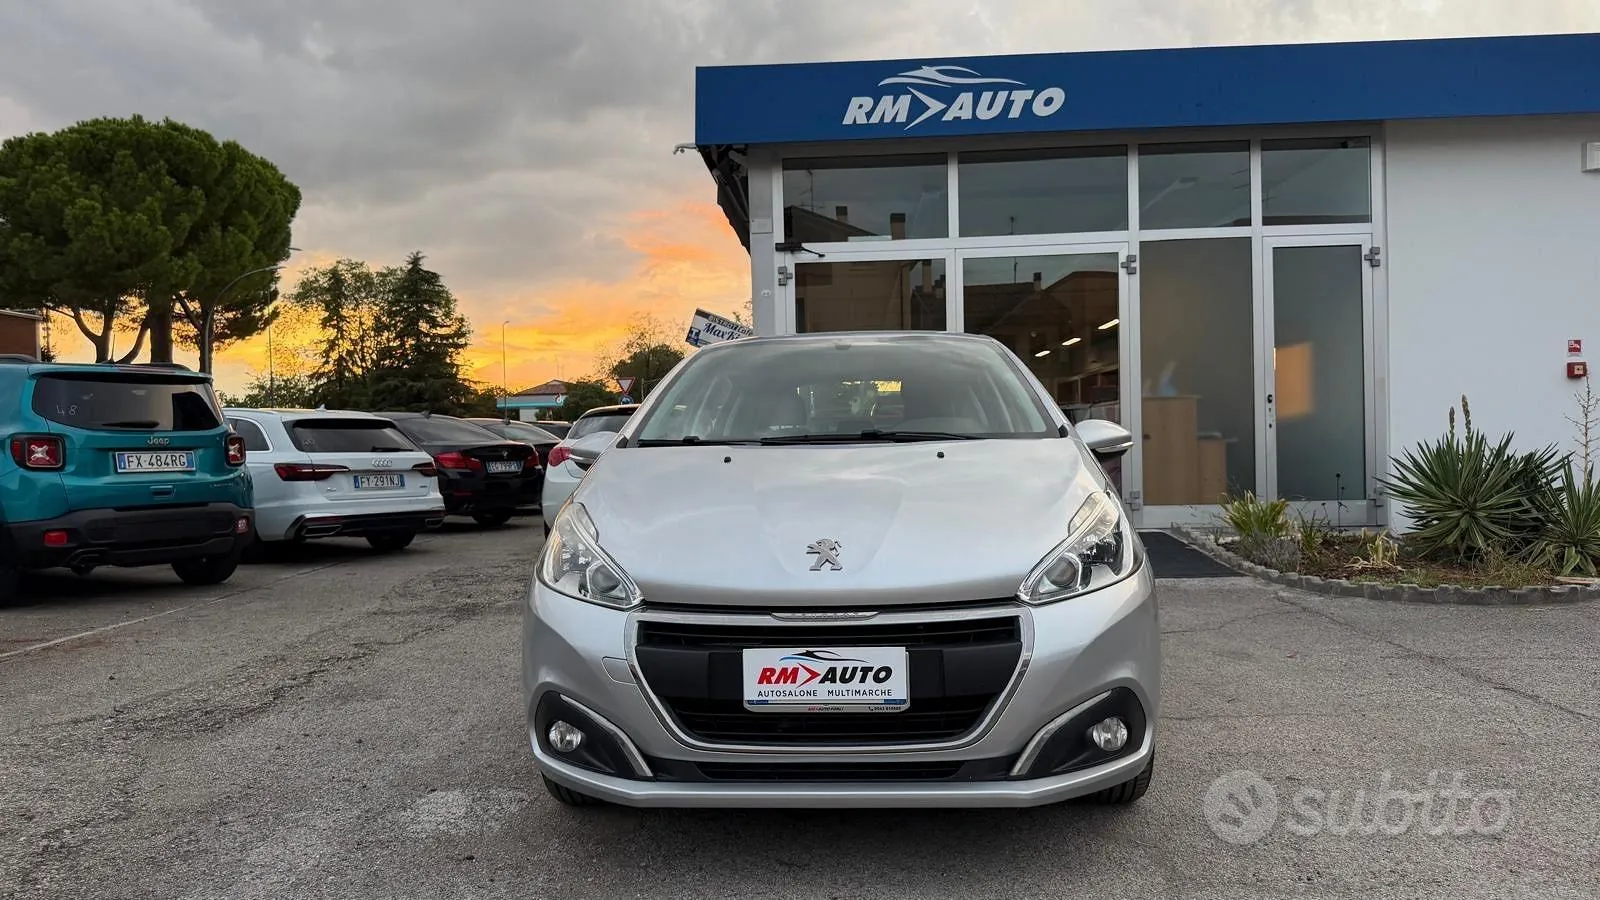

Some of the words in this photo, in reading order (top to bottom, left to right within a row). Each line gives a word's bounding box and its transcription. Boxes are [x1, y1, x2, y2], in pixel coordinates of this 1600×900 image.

[842, 94, 912, 125] RM
[941, 87, 1065, 121] AUTO
[147, 436, 170, 446] Jeep
[127, 454, 142, 468] FX
[757, 666, 800, 685] RM
[818, 665, 893, 684] AUTO
[757, 689, 818, 697] AUTOSALONE
[827, 689, 893, 697] MULTIMARCHE
